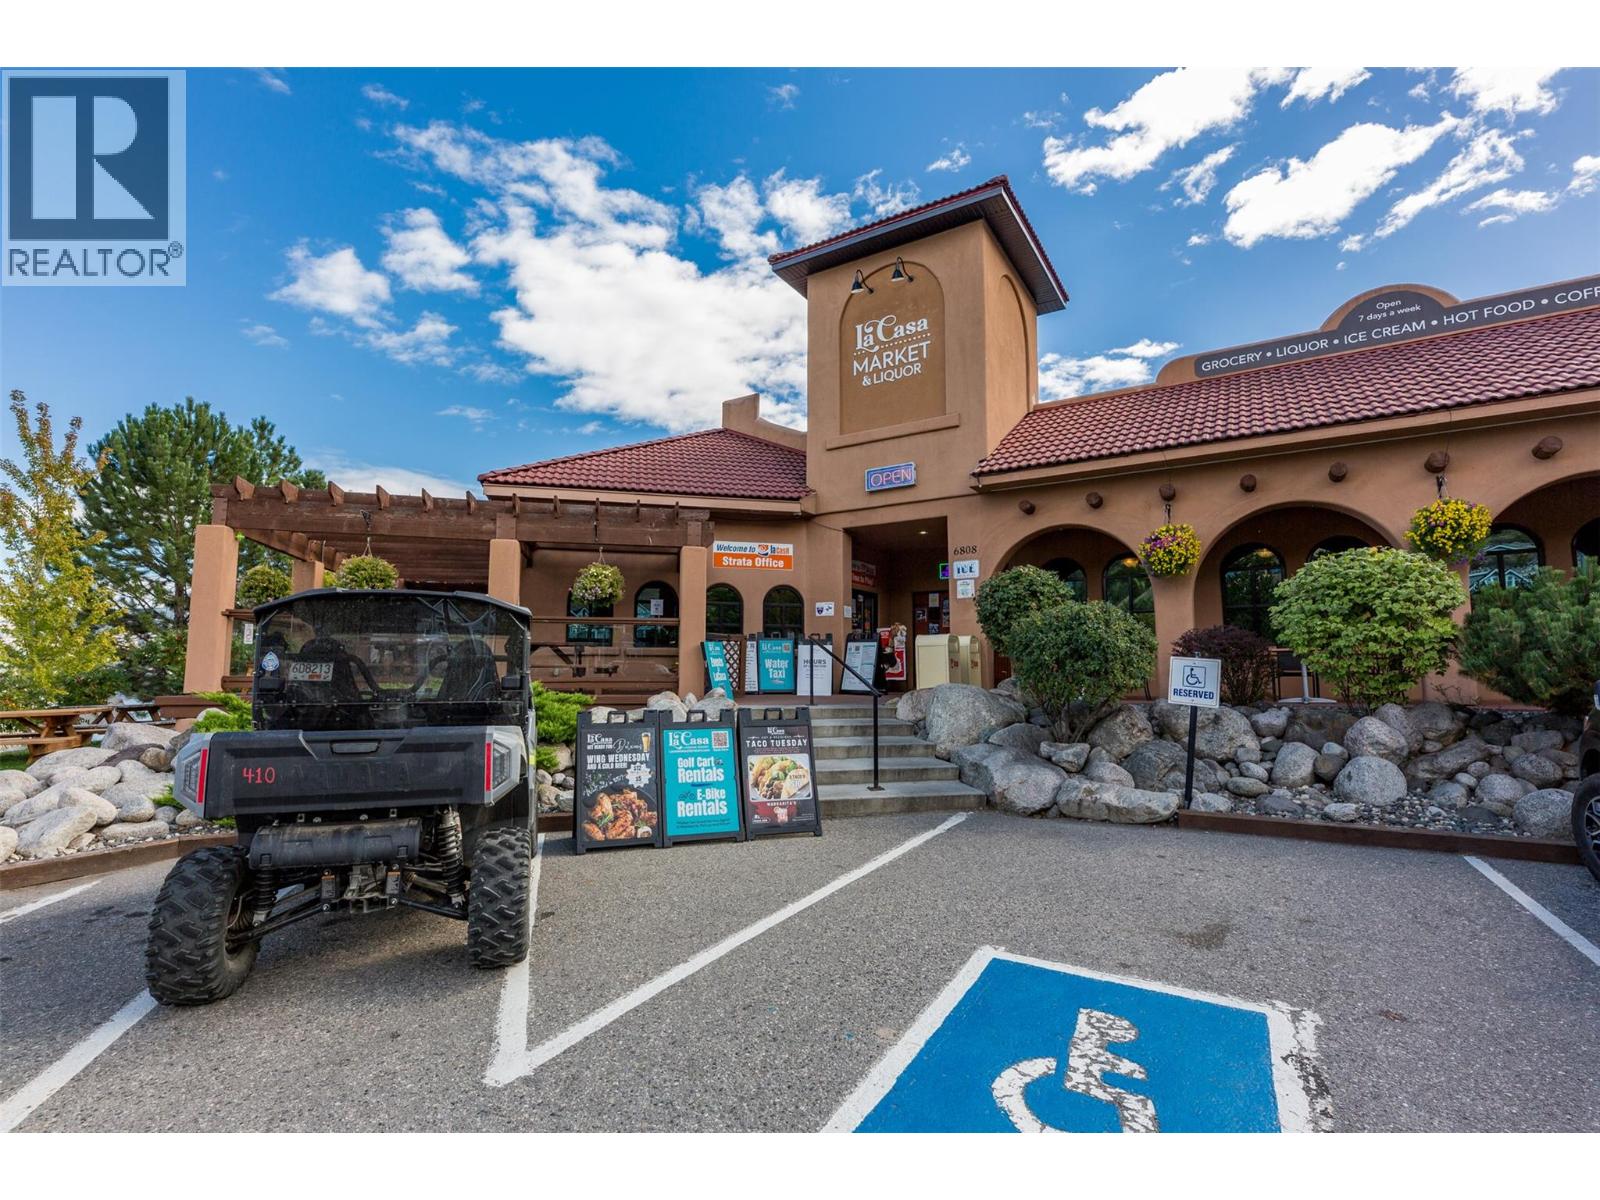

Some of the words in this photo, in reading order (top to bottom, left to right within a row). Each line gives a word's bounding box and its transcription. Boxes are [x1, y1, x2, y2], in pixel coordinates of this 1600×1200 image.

[1358, 314, 1364, 322] 7
[1366, 312, 1387, 321] days
[1397, 304, 1421, 314] week
[1376, 300, 1401, 310] Open
[866, 314, 929, 343] Casa
[1201, 351, 1263, 371] GROCERY
[1276, 338, 1329, 358] LIQUOR
[1344, 331, 1368, 345] ICE
[1371, 319, 1426, 339] CREAM
[1443, 309, 1478, 325] HOT
[1484, 299, 1536, 318] FOOD
[855, 322, 879, 353] La
[853, 340, 931, 377] MARKET
[862, 374, 872, 387] &
[873, 362, 922, 385] LIQUOR
[870, 468, 912, 487] OPEN
[716, 543, 748, 553] Welcome
[748, 545, 756, 553] to
[953, 545, 977, 556] 6808
[722, 555, 753, 567] Strata
[755, 557, 785, 568] Office
[764, 658, 789, 669] Water
[769, 668, 786, 679] Taxi
[1173, 688, 1215, 700] RESERVED
[669, 731, 682, 749] La
[680, 731, 709, 746] Casa
[746, 740, 768, 748] TACO
[770, 738, 808, 748] TUESDAY
[587, 754, 606, 764] WING
[608, 753, 650, 762] WEDNESDAY
[677, 757, 695, 768] Golf
[696, 756, 715, 768] Cart
[242, 766, 276, 785] 410
[678, 766, 725, 784] Rentals
[696, 787, 726, 801] E-Bike
[677, 799, 728, 818] Rentals
